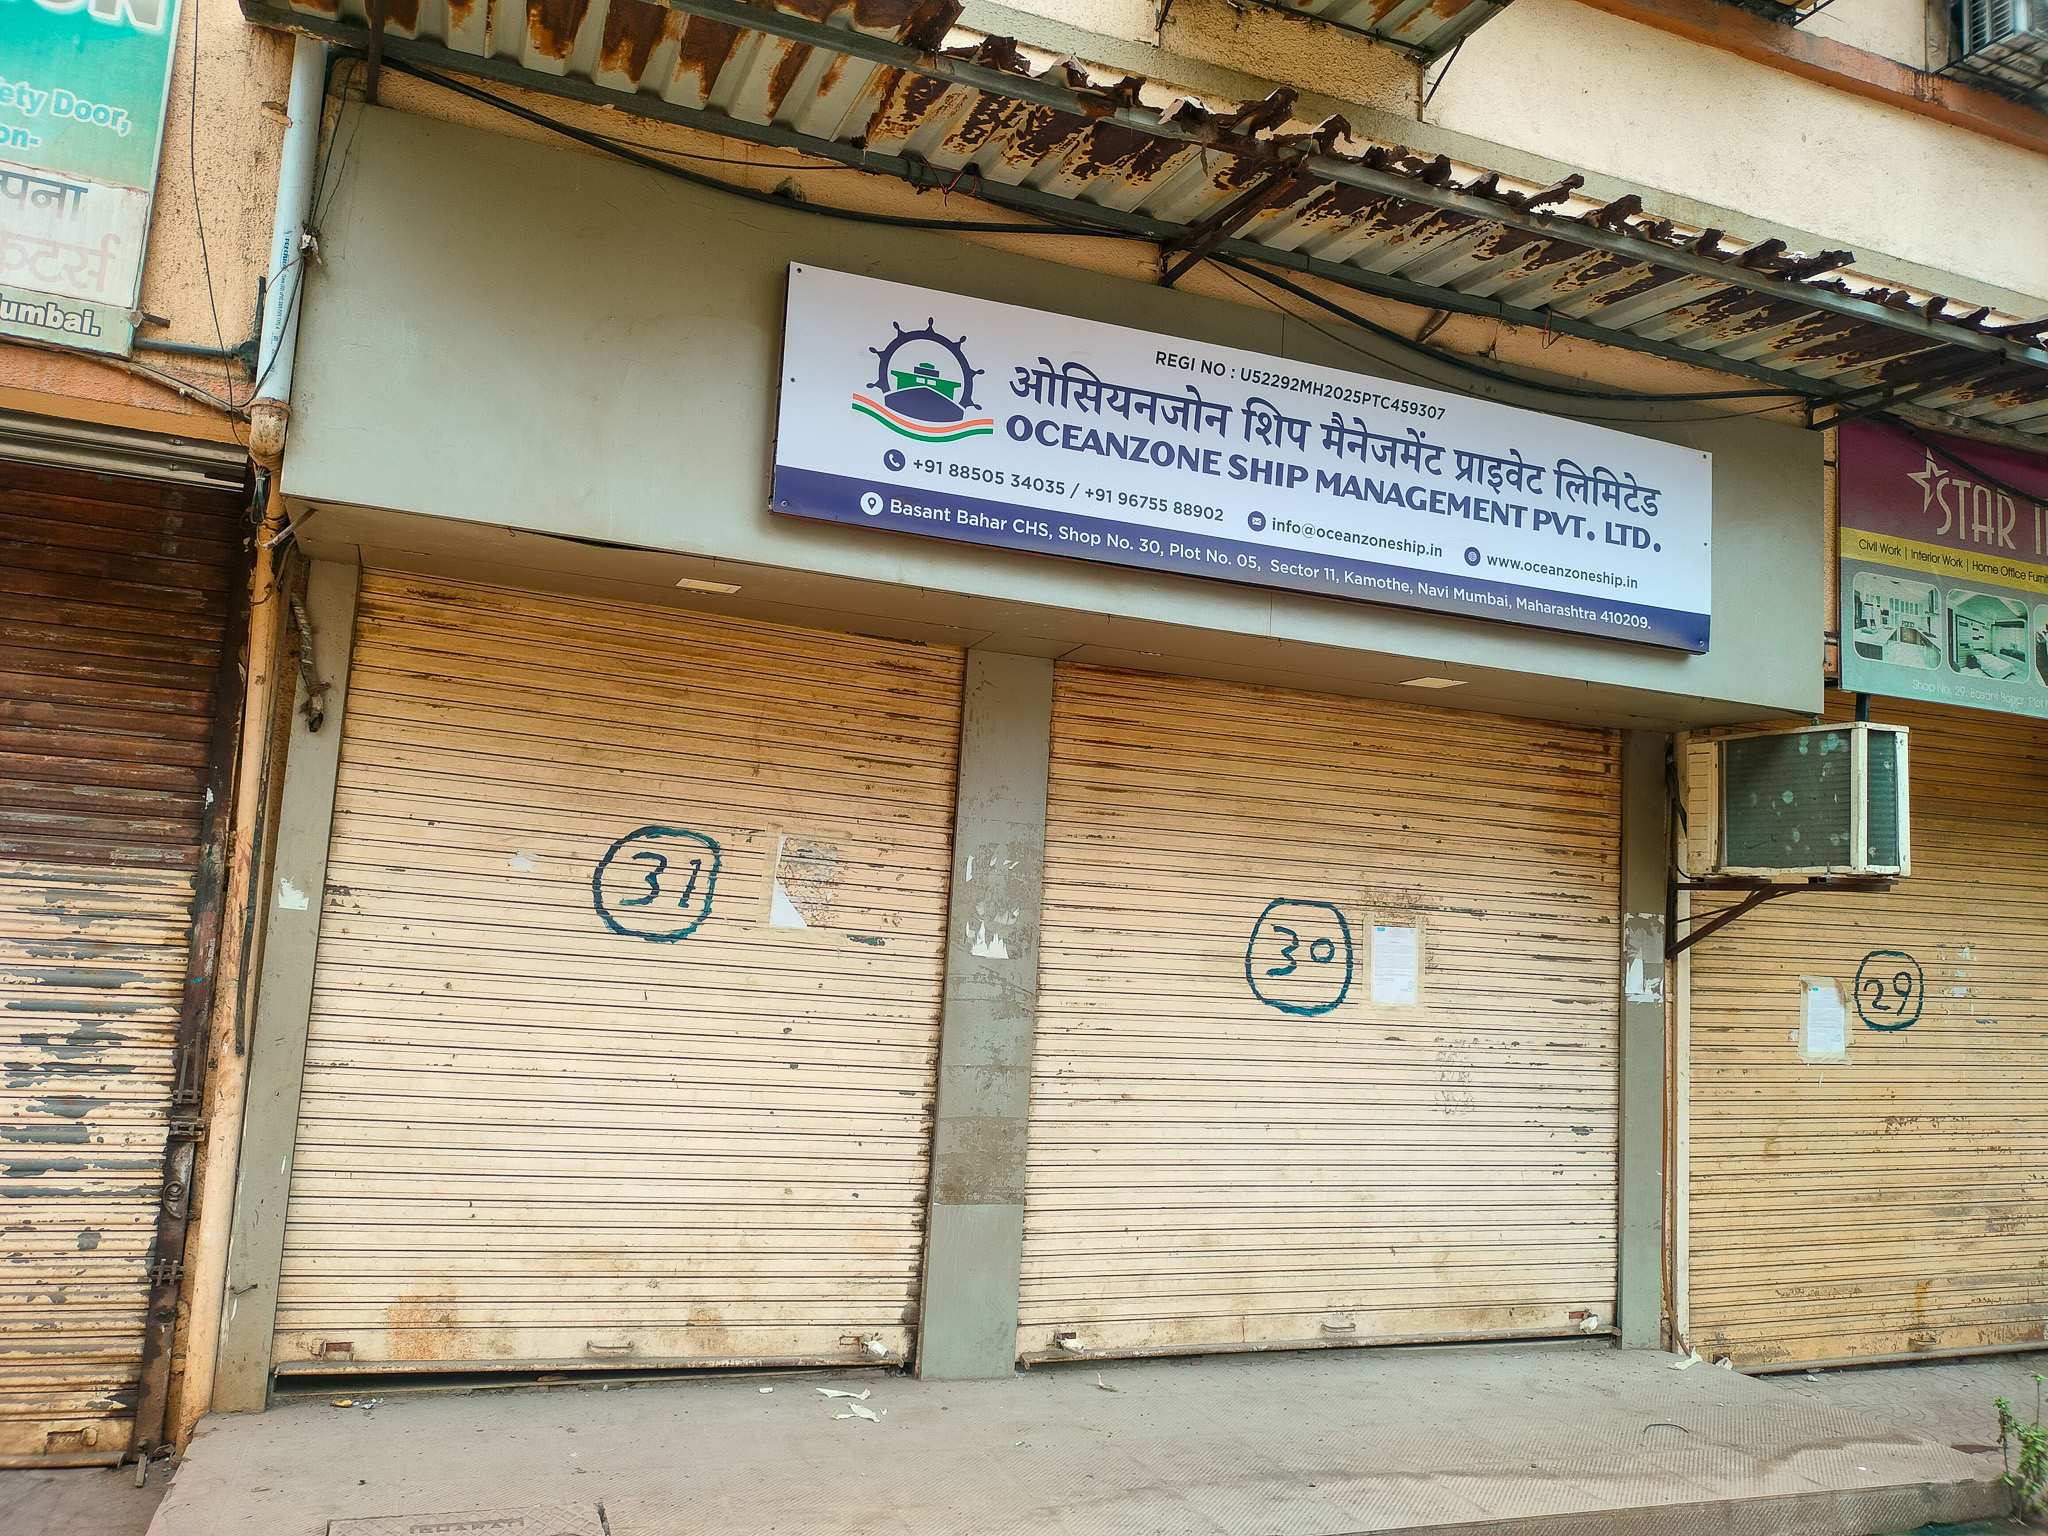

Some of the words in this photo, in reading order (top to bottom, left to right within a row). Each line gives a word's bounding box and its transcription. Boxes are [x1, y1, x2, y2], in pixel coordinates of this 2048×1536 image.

[51, 88, 131, 137] Door,
[0, 170, 89, 222] पना
[0, 293, 101, 337] umbai.
[1154, 349, 1196, 372] REGI
[1199, 358, 1226, 377] NO
[1239, 366, 1446, 421] U52292MH2025PTC459307
[1008, 355, 1234, 438] ओसियनजोन
[1239, 395, 1313, 453] शिप
[1318, 410, 1447, 476] मैनेजमेंट
[1451, 447, 1547, 495] प्राइवेट
[1551, 457, 1663, 517] लिमिटेड
[912, 458, 943, 475] +91
[947, 462, 1005, 485] 88505
[1009, 472, 1065, 495] 34035
[1084, 487, 1112, 503] +91
[1117, 491, 1168, 512] 96755
[1172, 500, 1224, 522] 88902
[1004, 413, 1223, 477] OCEANZONE
[1226, 452, 1309, 489] SHIP
[1314, 468, 1529, 529] MANAGEMENT
[1531, 507, 1595, 541] PVT.
[1604, 520, 1662, 553] LTD.
[1271, 516, 1442, 558] info@oceanzoneship.in
[1936, 477, 2017, 550] STAR
[889, 497, 951, 522] Basant
[955, 508, 1008, 531] Bahar
[1011, 517, 1053, 540] CHS,
[1057, 524, 1101, 547] Shop
[1105, 532, 1134, 551] No.
[1137, 537, 1164, 557] 30,
[1168, 541, 1201, 561] Plot
[1205, 547, 1232, 566] No.
[1235, 552, 1261, 572] 05,
[1269, 558, 1320, 579] Sector
[1322, 566, 1340, 584] 11,
[1343, 569, 1413, 595] Kamothe,
[1417, 580, 1449, 599] Navi
[1452, 586, 1512, 610] Mumbai,
[1515, 595, 1597, 621] Maharashtra
[1599, 609, 1652, 630] 410209.
[1485, 554, 1638, 589] www.oceanzoneship.in
[1858, 538, 1878, 552] Civil
[1877, 542, 1902, 557] Work
[1911, 548, 1941, 564] Interior
[1941, 551, 1963, 568] Work
[1972, 560, 1999, 575] Home
[2000, 565, 2026, 580] Office
[1912, 679, 1935, 693] Shop
[1970, 687, 1999, 702] Basant
[619, 851, 703, 909] 31
[1266, 924, 1335, 977] 30
[1863, 971, 1911, 1017] 29
